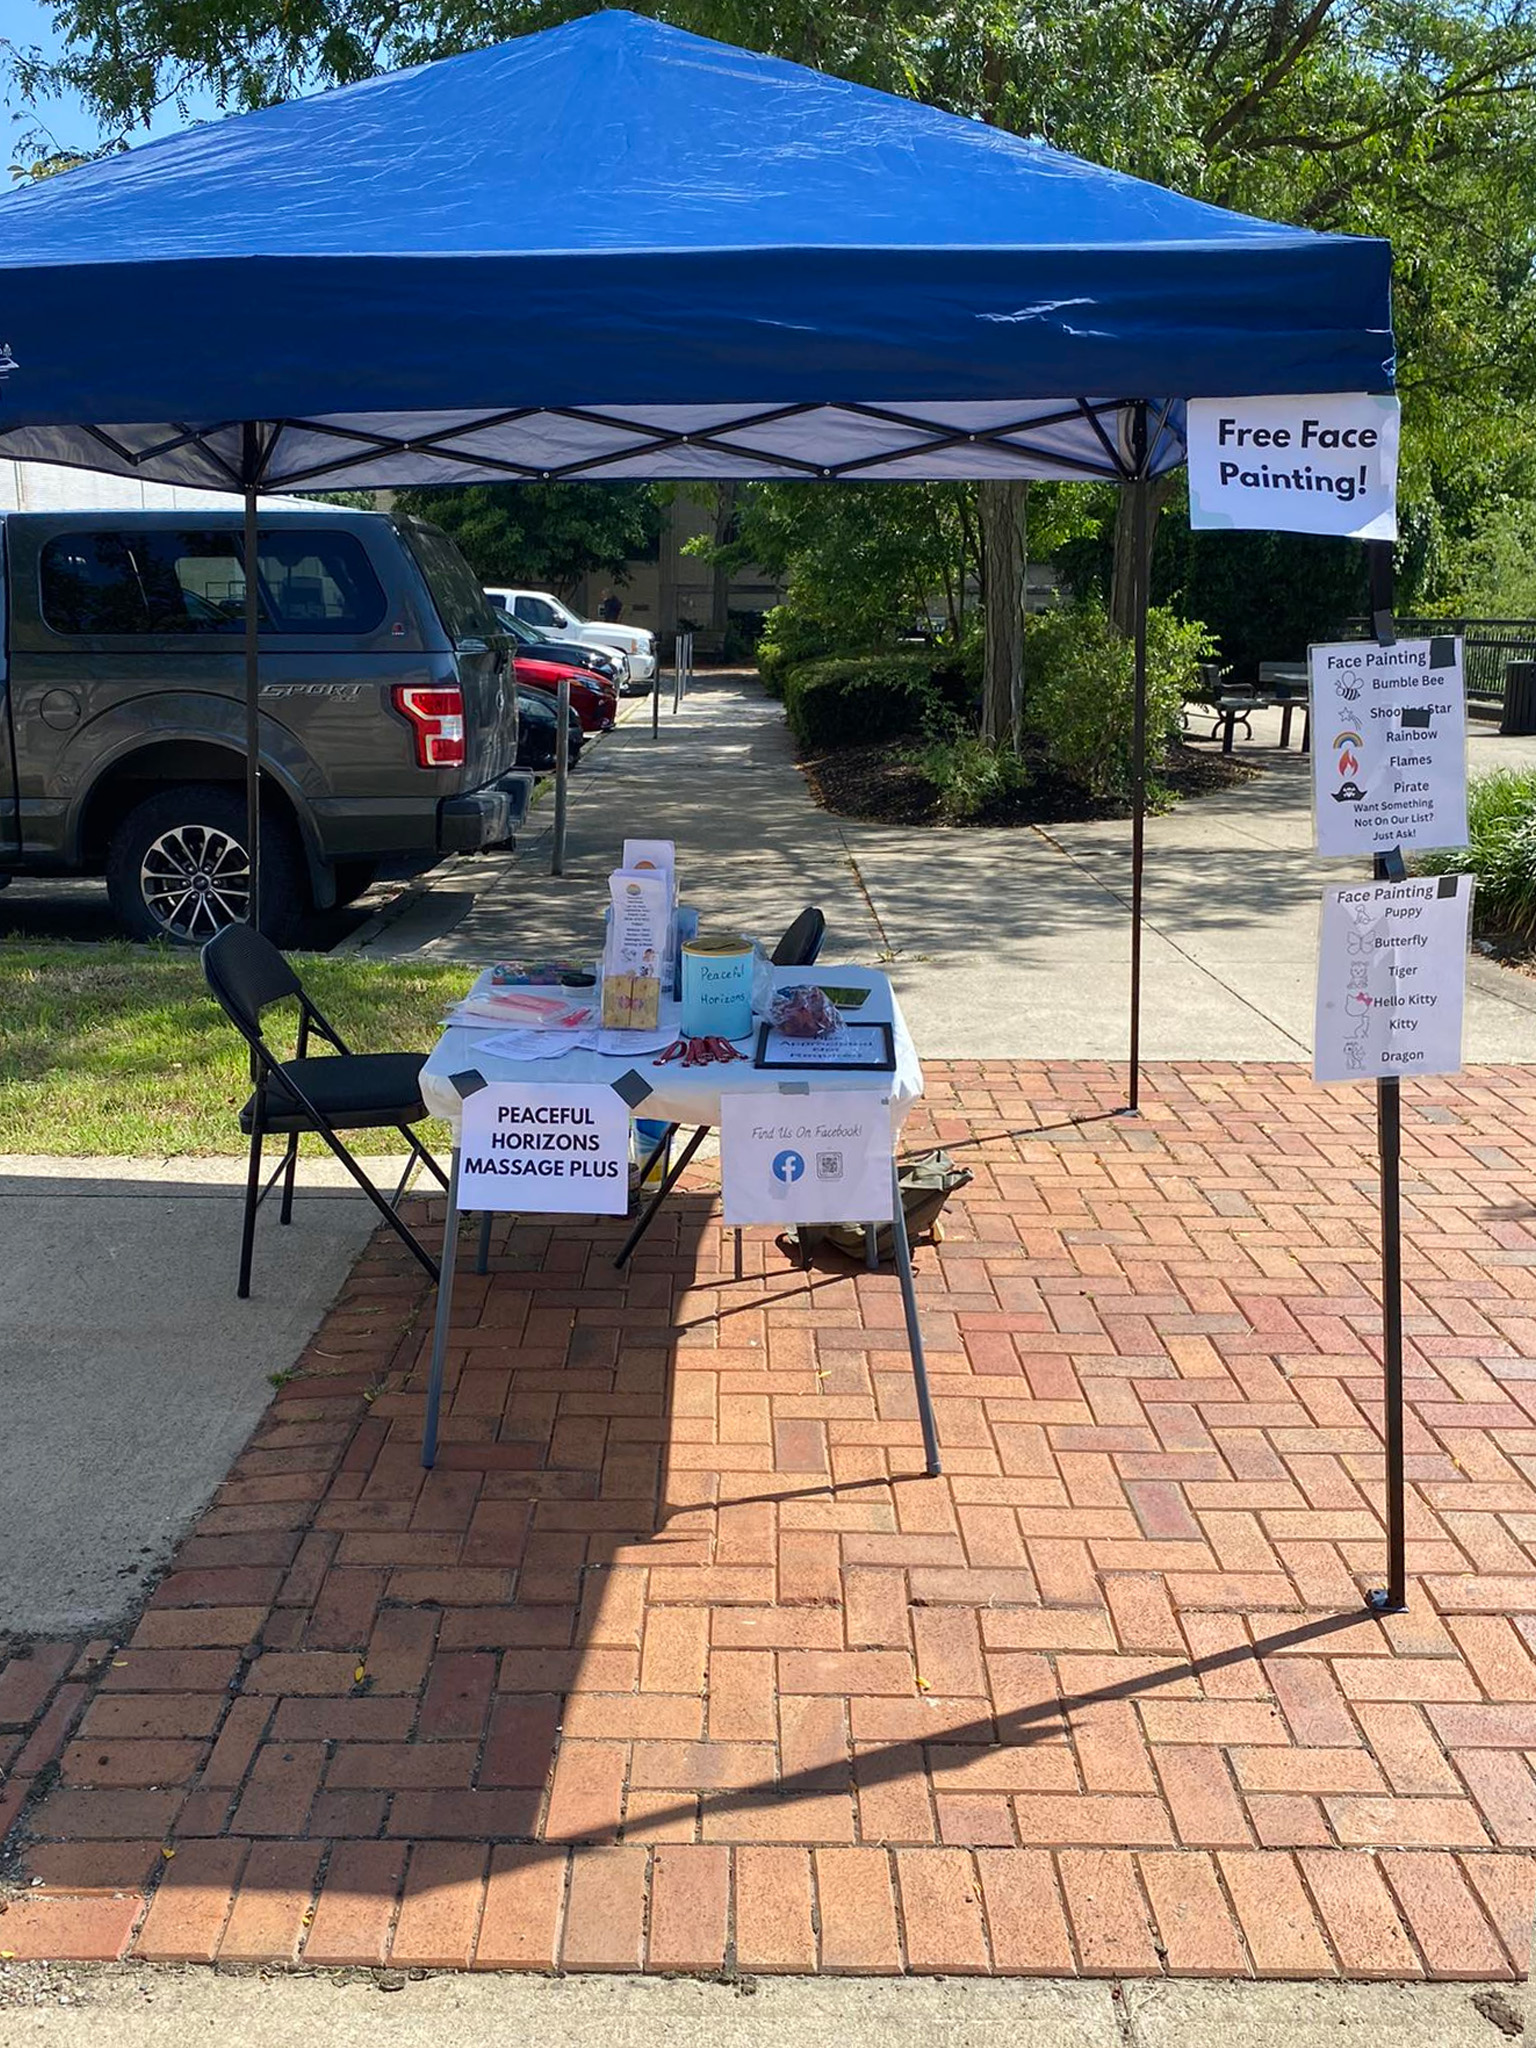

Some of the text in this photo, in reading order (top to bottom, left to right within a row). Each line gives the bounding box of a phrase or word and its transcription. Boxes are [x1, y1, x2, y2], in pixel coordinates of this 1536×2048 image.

[1218, 418, 1378, 449] Free Face
[1219, 461, 1367, 502] Painting!
[1327, 650, 1427, 669] Face Painting
[258, 683, 374, 697] SPORT
[1372, 675, 1445, 690] Bumble Bee
[1370, 703, 1452, 719] Shoo Star
[1386, 729, 1438, 742] Rainbow
[1389, 755, 1432, 767] Flames
[1393, 781, 1430, 793] Pirate
[1353, 799, 1434, 813] Want Something
[1354, 812, 1434, 828] Not On Our List?
[1373, 829, 1417, 841] Just Ask!
[1337, 885, 1434, 904] Face Painting
[1384, 906, 1422, 919] Puppy
[1374, 934, 1428, 949] Butterfly
[701, 963, 745, 981] Peaceful
[1388, 965, 1418, 978] Tiger
[701, 992, 745, 1005] Horizons
[1373, 993, 1438, 1008] Hello Kitty
[1389, 1019, 1419, 1031] Kitty
[1381, 1050, 1425, 1063] Dragon
[498, 1106, 595, 1125] PEACEFUL
[752, 1124, 862, 1139] Find Us On Facebook!
[491, 1132, 600, 1151] HORIZONS
[464, 1157, 619, 1178] MASSAGE PLUS
